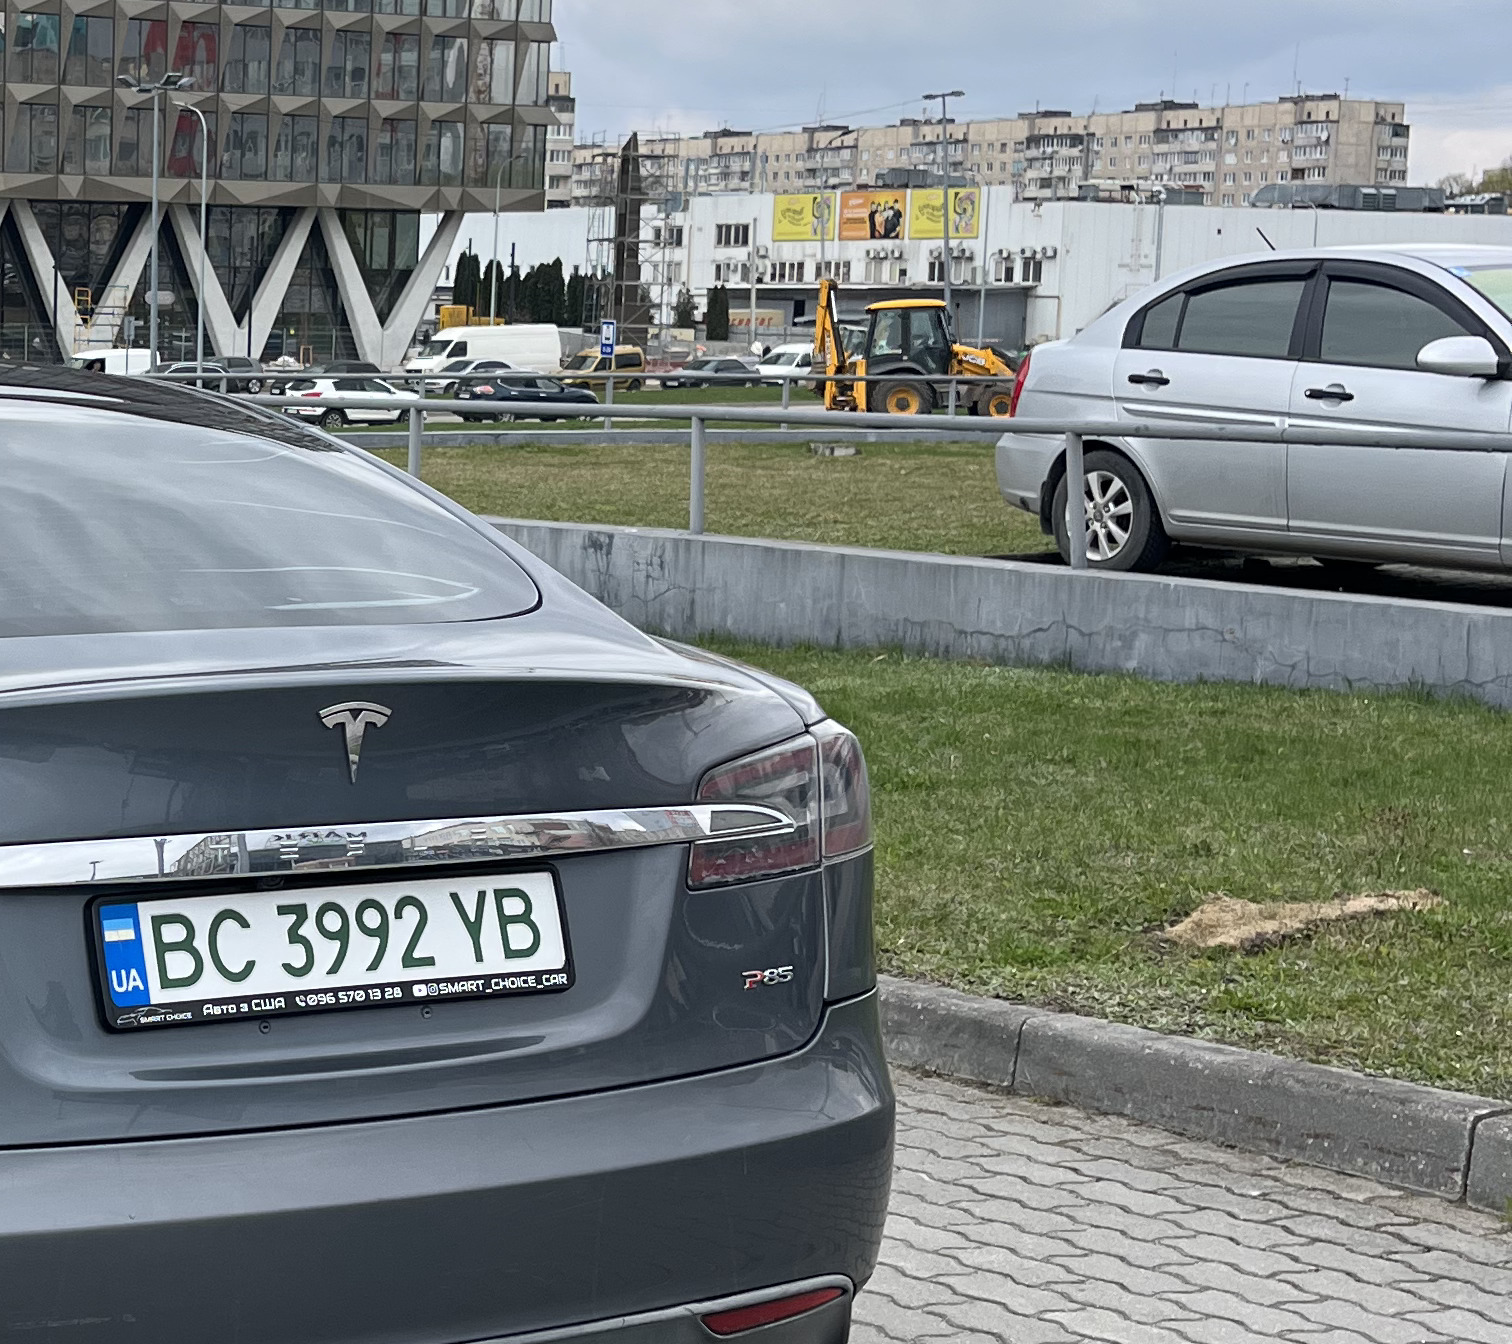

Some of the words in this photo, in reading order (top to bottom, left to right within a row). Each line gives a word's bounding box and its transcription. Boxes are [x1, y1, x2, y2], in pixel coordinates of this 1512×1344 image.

[151, 908, 256, 989] BC
[277, 895, 436, 978] 3992
[449, 887, 541, 963] YB
[111, 968, 144, 993] UA
[438, 973, 568, 994] SMART_CHOICE_CAR
[741, 965, 794, 990] P85
[202, 1003, 237, 1016] Авто
[251, 996, 286, 1011] США
[307, 992, 336, 1006] 096
[337, 990, 366, 1004] 570
[367, 988, 382, 1001] 13
[384, 986, 403, 999] 28
[139, 1013, 165, 1024] SMART
[166, 1011, 193, 1022] CHOICE
